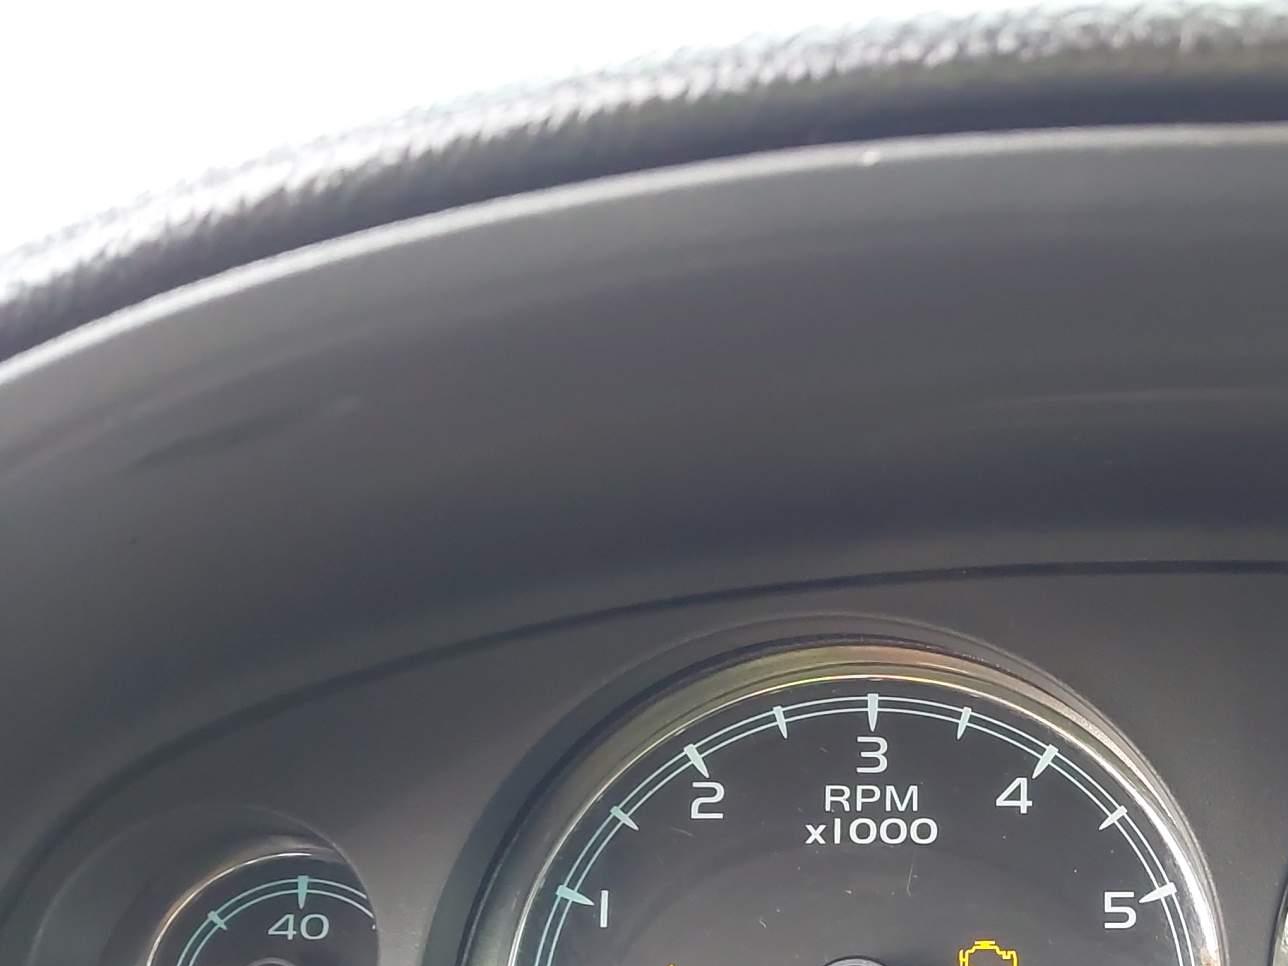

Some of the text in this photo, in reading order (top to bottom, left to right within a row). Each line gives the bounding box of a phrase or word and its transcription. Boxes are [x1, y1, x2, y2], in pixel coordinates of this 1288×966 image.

[854, 736, 889, 774] 3
[691, 782, 725, 819] 2
[822, 785, 920, 812] RPM
[995, 777, 1033, 814] 4
[805, 818, 938, 845] x1000
[597, 888, 609, 929] 1
[1103, 891, 1138, 929] 5
[268, 914, 329, 941] 40
